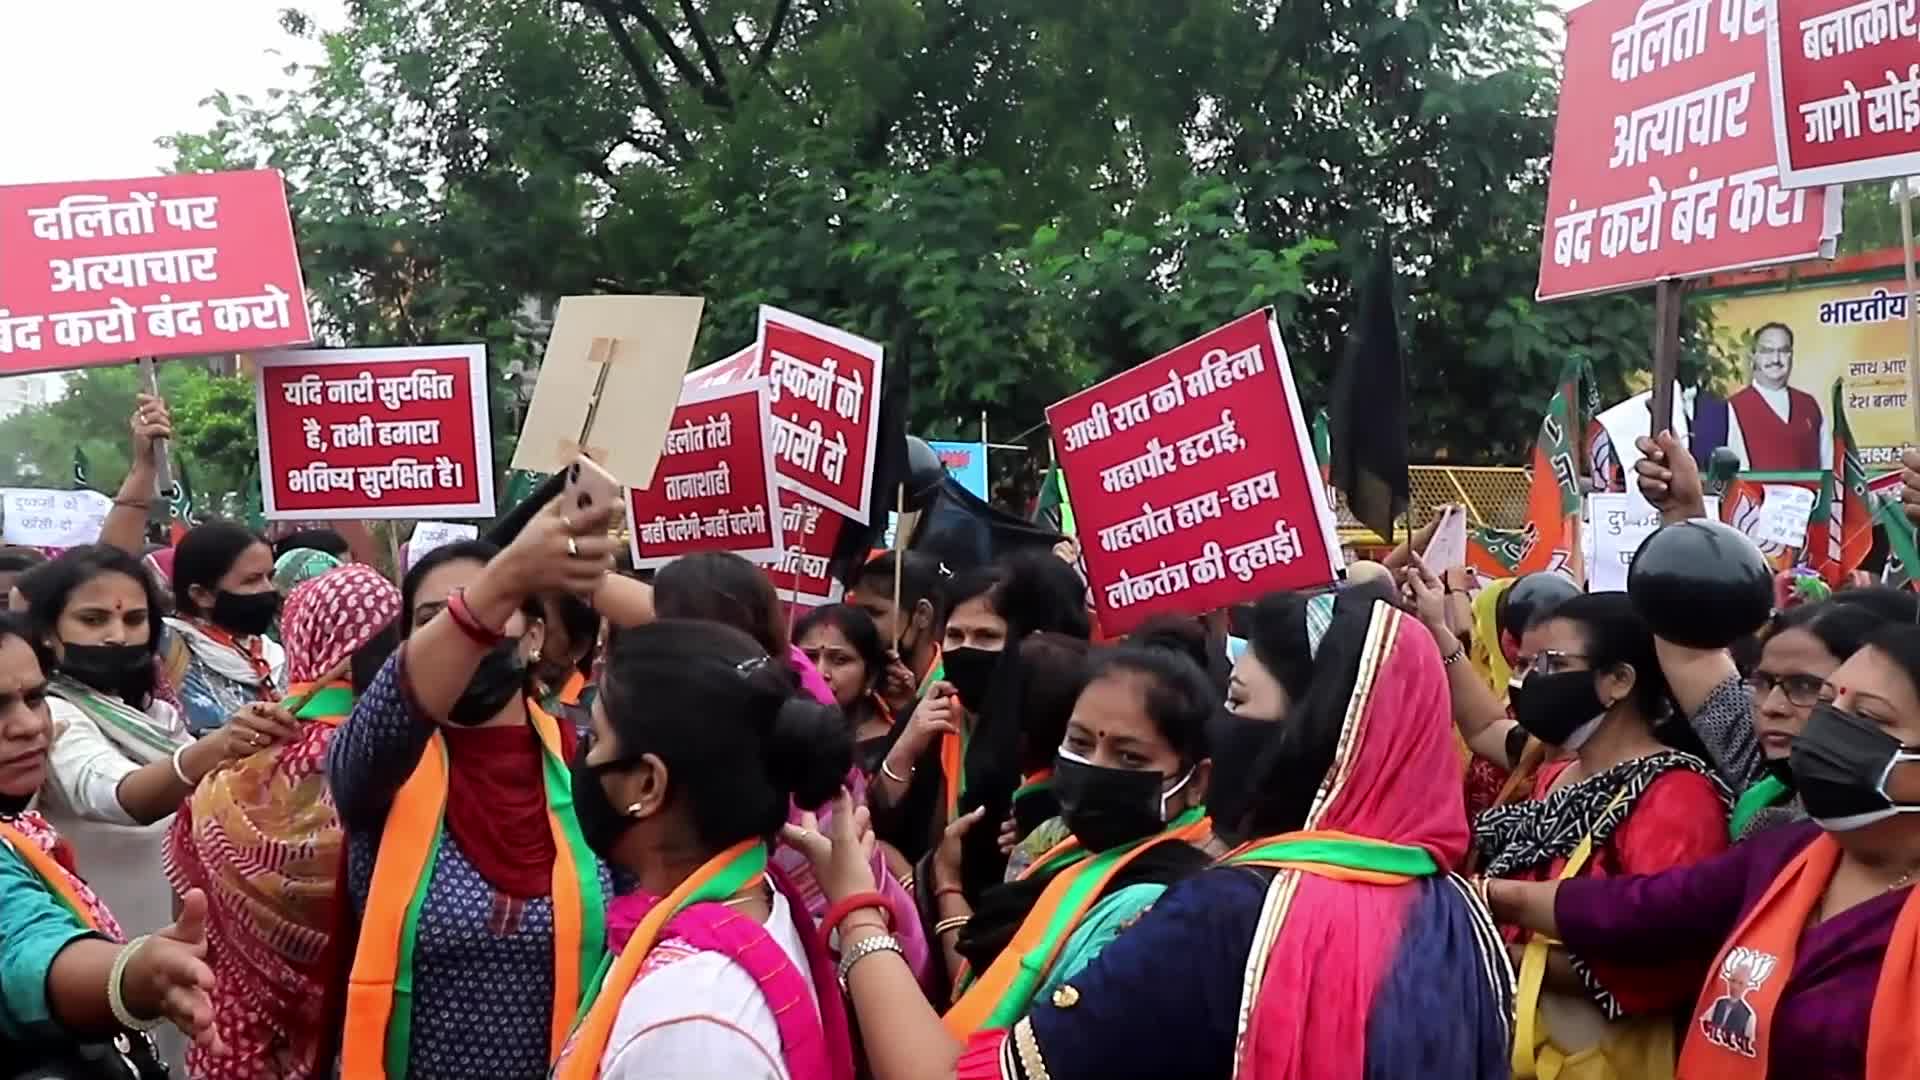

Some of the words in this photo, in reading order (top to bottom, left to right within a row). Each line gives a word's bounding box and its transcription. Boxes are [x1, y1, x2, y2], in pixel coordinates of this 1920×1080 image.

[1609, 72, 1756, 169] अत्याचार
[1799, 79, 1861, 144] जागो
[27, 191, 155, 241] दलितों
[159, 195, 218, 231] पर
[1554, 199, 1597, 267] बंद
[1600, 176, 1666, 259] करो
[1670, 166, 1724, 244] बंद
[49, 247, 218, 293] अत्याचार
[48, 297, 136, 348] करो
[142, 292, 203, 339] बंद
[208, 283, 290, 334] करो
[1820, 290, 1908, 325] भारतीय
[282, 374, 323, 406] यदि
[326, 370, 374, 404] नारी
[376, 369, 454, 410] सुरक्षित
[835, 369, 864, 424] को
[1063, 401, 1111, 452] आधी
[1110, 394, 1151, 431] रात
[1149, 369, 1185, 413] को
[1184, 344, 1265, 398] महिला
[303, 418, 328, 453] है,
[330, 415, 375, 450] तभी
[376, 419, 440, 447] हमारा
[662, 419, 705, 456] हलोत
[705, 412, 731, 448] तेरी
[822, 430, 848, 485] दो
[1101, 433, 1177, 493] महापौर
[1176, 409, 1246, 466] हटाई,
[288, 461, 355, 493] भविष्य
[357, 457, 433, 499] सुरक्षित
[435, 456, 463, 488] है।
[664, 460, 730, 501] तानाशाही
[640, 515, 667, 544] नहीं
[729, 504, 766, 534] चलेगी
[1098, 503, 1175, 552] गहलोत
[1174, 471, 1281, 523] हाय-हाय
[1105, 561, 1191, 610] लोकतंत्र
[1190, 541, 1226, 583] की
[1228, 520, 1303, 582] दुहाई।
